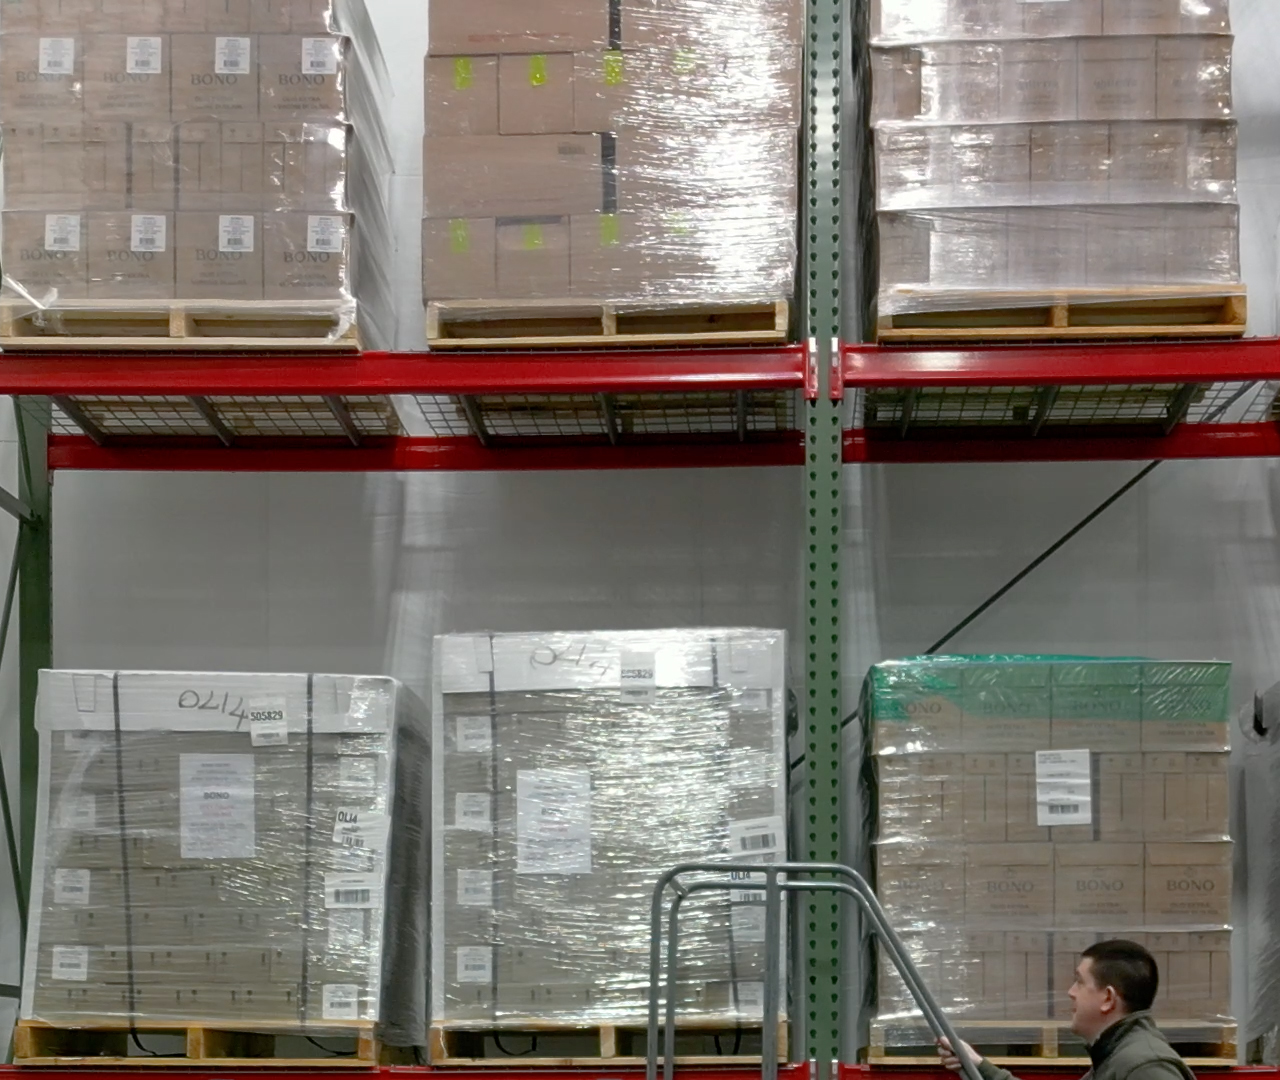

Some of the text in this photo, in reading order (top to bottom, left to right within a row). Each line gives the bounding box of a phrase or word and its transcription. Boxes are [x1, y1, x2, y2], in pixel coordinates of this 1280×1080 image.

[15, 72, 63, 84] BONO
[104, 72, 150, 84] BONO
[191, 73, 238, 86] BONO
[278, 73, 325, 86] BONO
[20, 249, 66, 261] BONO
[107, 250, 154, 262] BONO
[195, 248, 242, 261] BONO
[283, 251, 330, 264] BONO
[250, 710, 283, 721] 505829
[203, 791, 230, 800] BONO
[987, 880, 1035, 893] BONO
[1076, 879, 1124, 892] BONO
[1166, 879, 1215, 892] BONO
